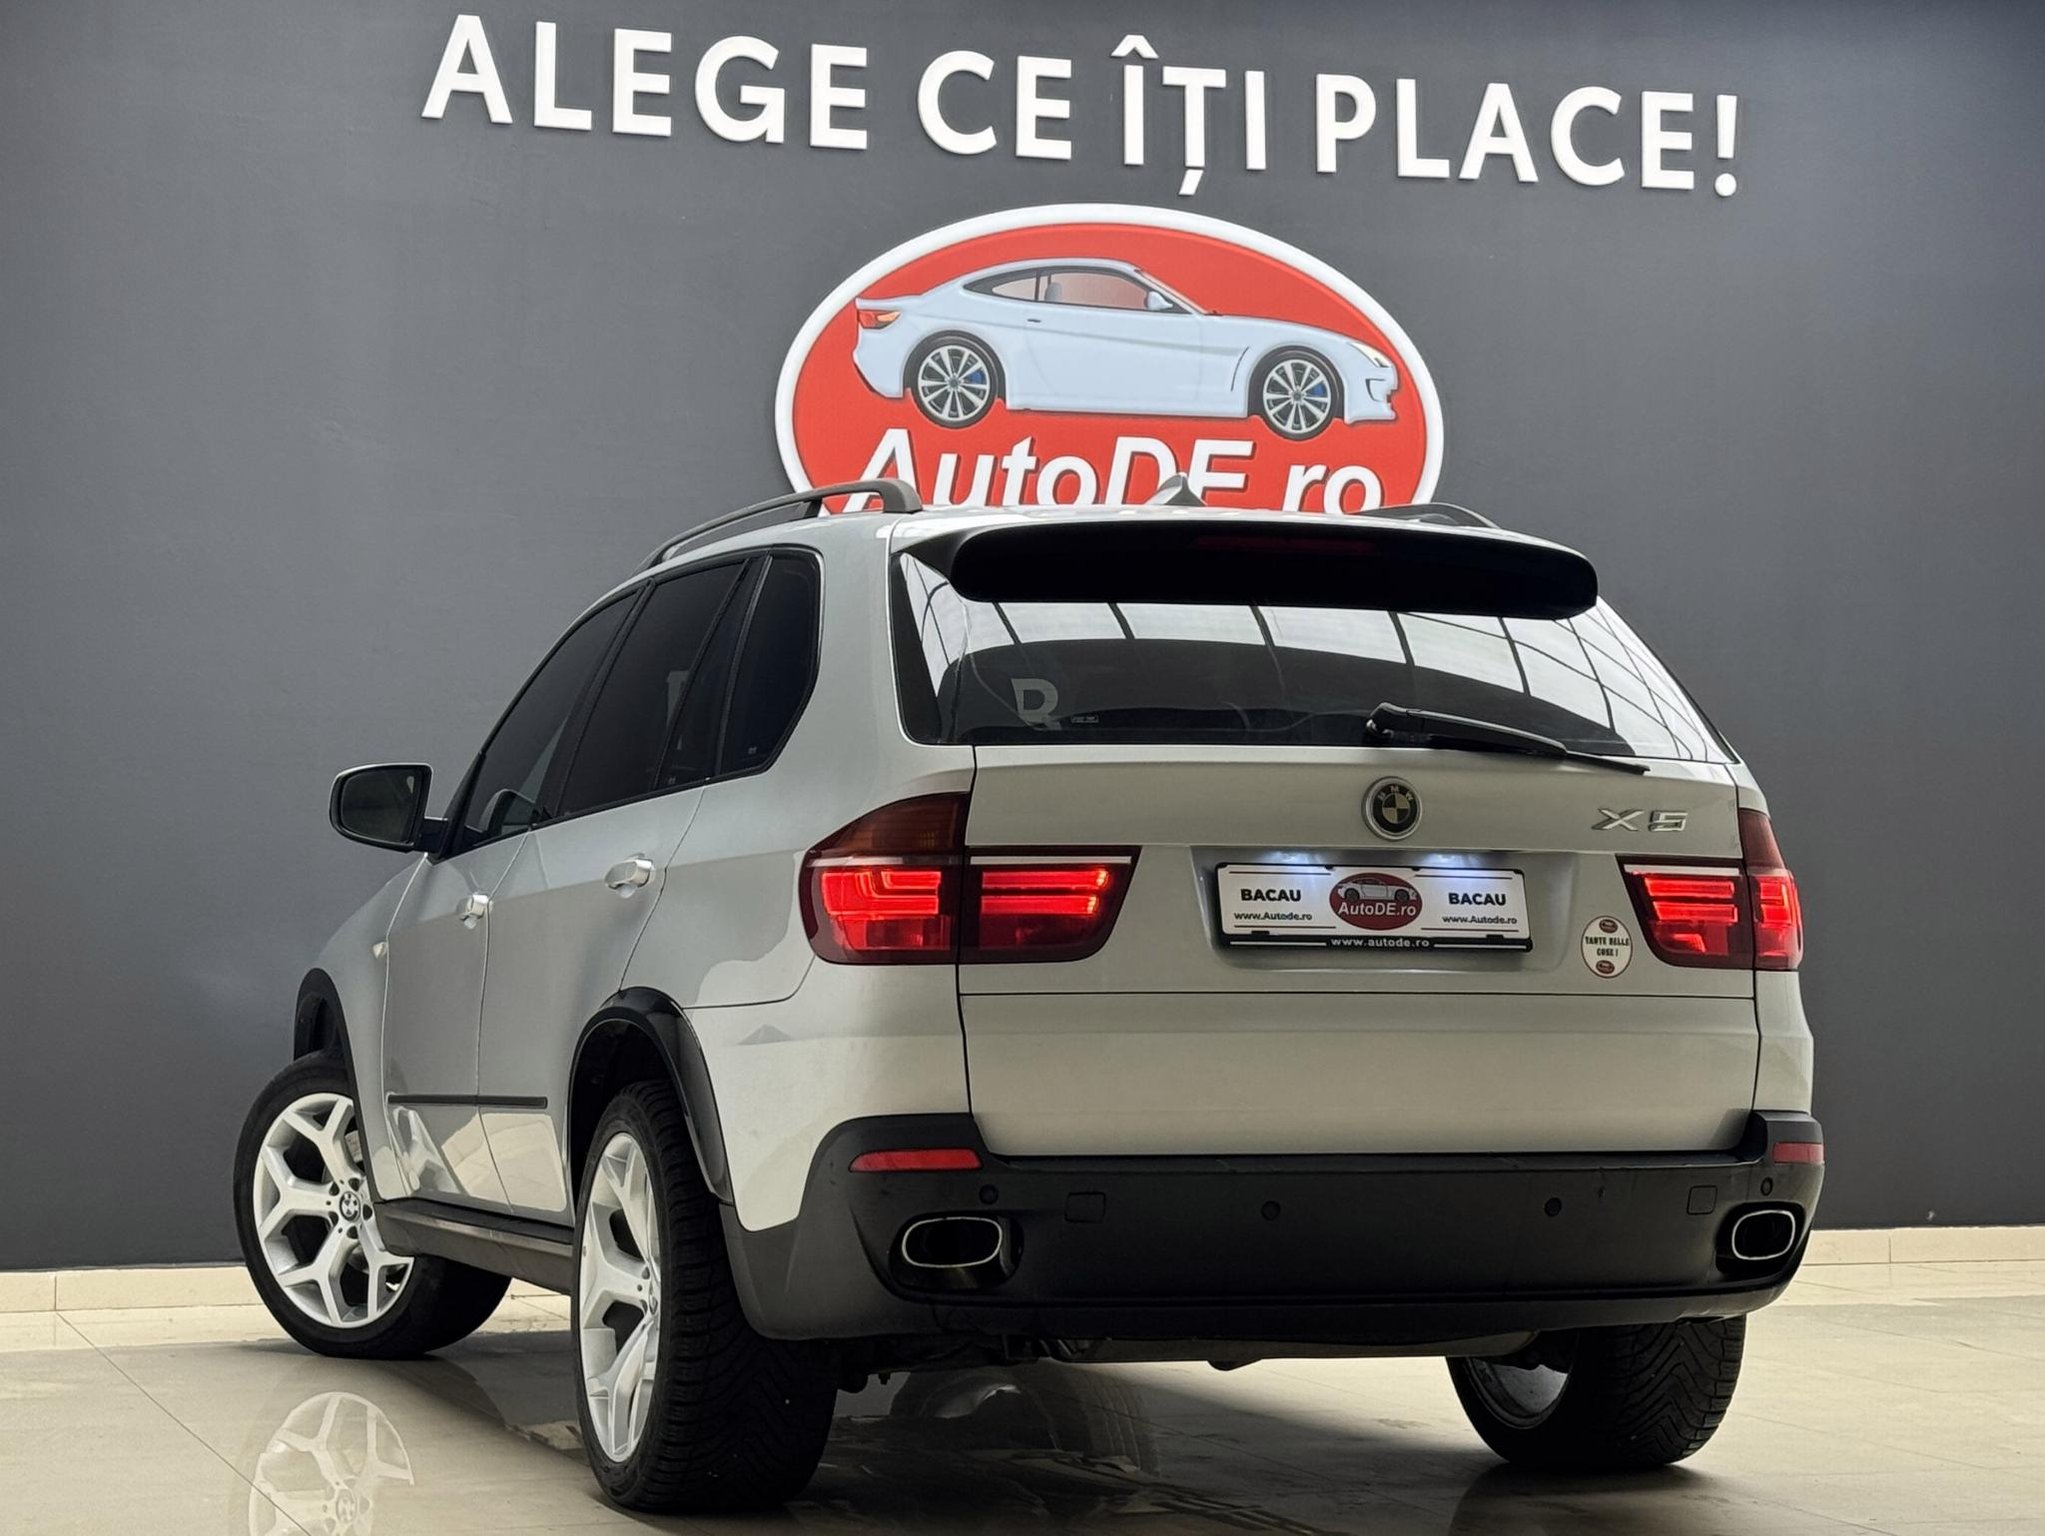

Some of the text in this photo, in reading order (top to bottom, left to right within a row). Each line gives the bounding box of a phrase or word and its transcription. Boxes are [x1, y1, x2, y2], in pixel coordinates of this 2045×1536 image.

[421, 14, 1737, 197] ALEGE CE ÎȚI PLACE!
[842, 428, 1383, 514] AutoDEro
[1591, 808, 1688, 831] X5
[1240, 888, 1301, 901] BACAU
[1448, 892, 1506, 906] BACAU
[1234, 911, 1312, 921] www.Autode.ro
[1338, 901, 1416, 917] AutoDE.ro
[1442, 915, 1517, 925] www.Autode.ro
[1331, 937, 1430, 948] www.autode.ro
